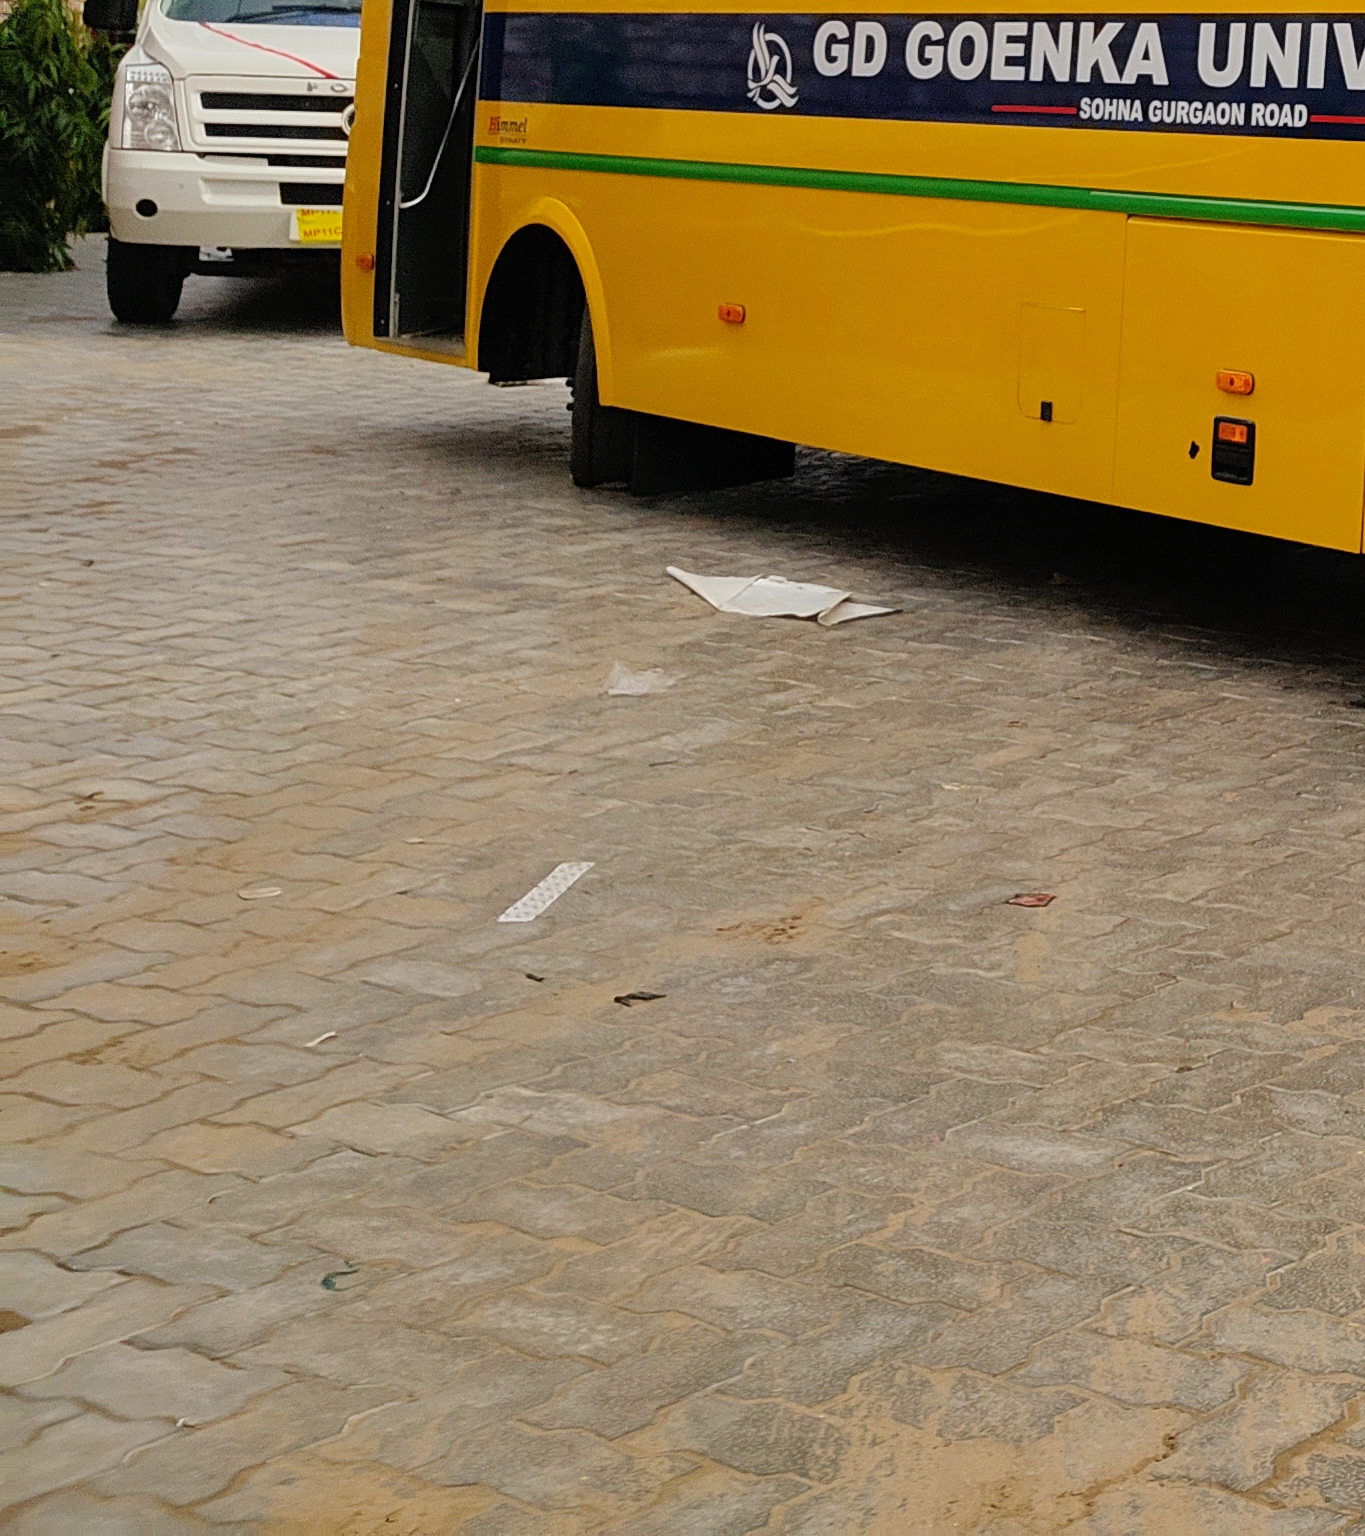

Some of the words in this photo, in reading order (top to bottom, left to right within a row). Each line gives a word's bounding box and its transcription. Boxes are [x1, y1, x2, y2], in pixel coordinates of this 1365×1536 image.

[812, 20, 888, 77] GD
[905, 20, 1169, 86] GOENKA
[1078, 96, 1143, 122] SOHNA
[1148, 98, 1246, 126] GURGAON
[1250, 101, 1309, 128] ROAD
